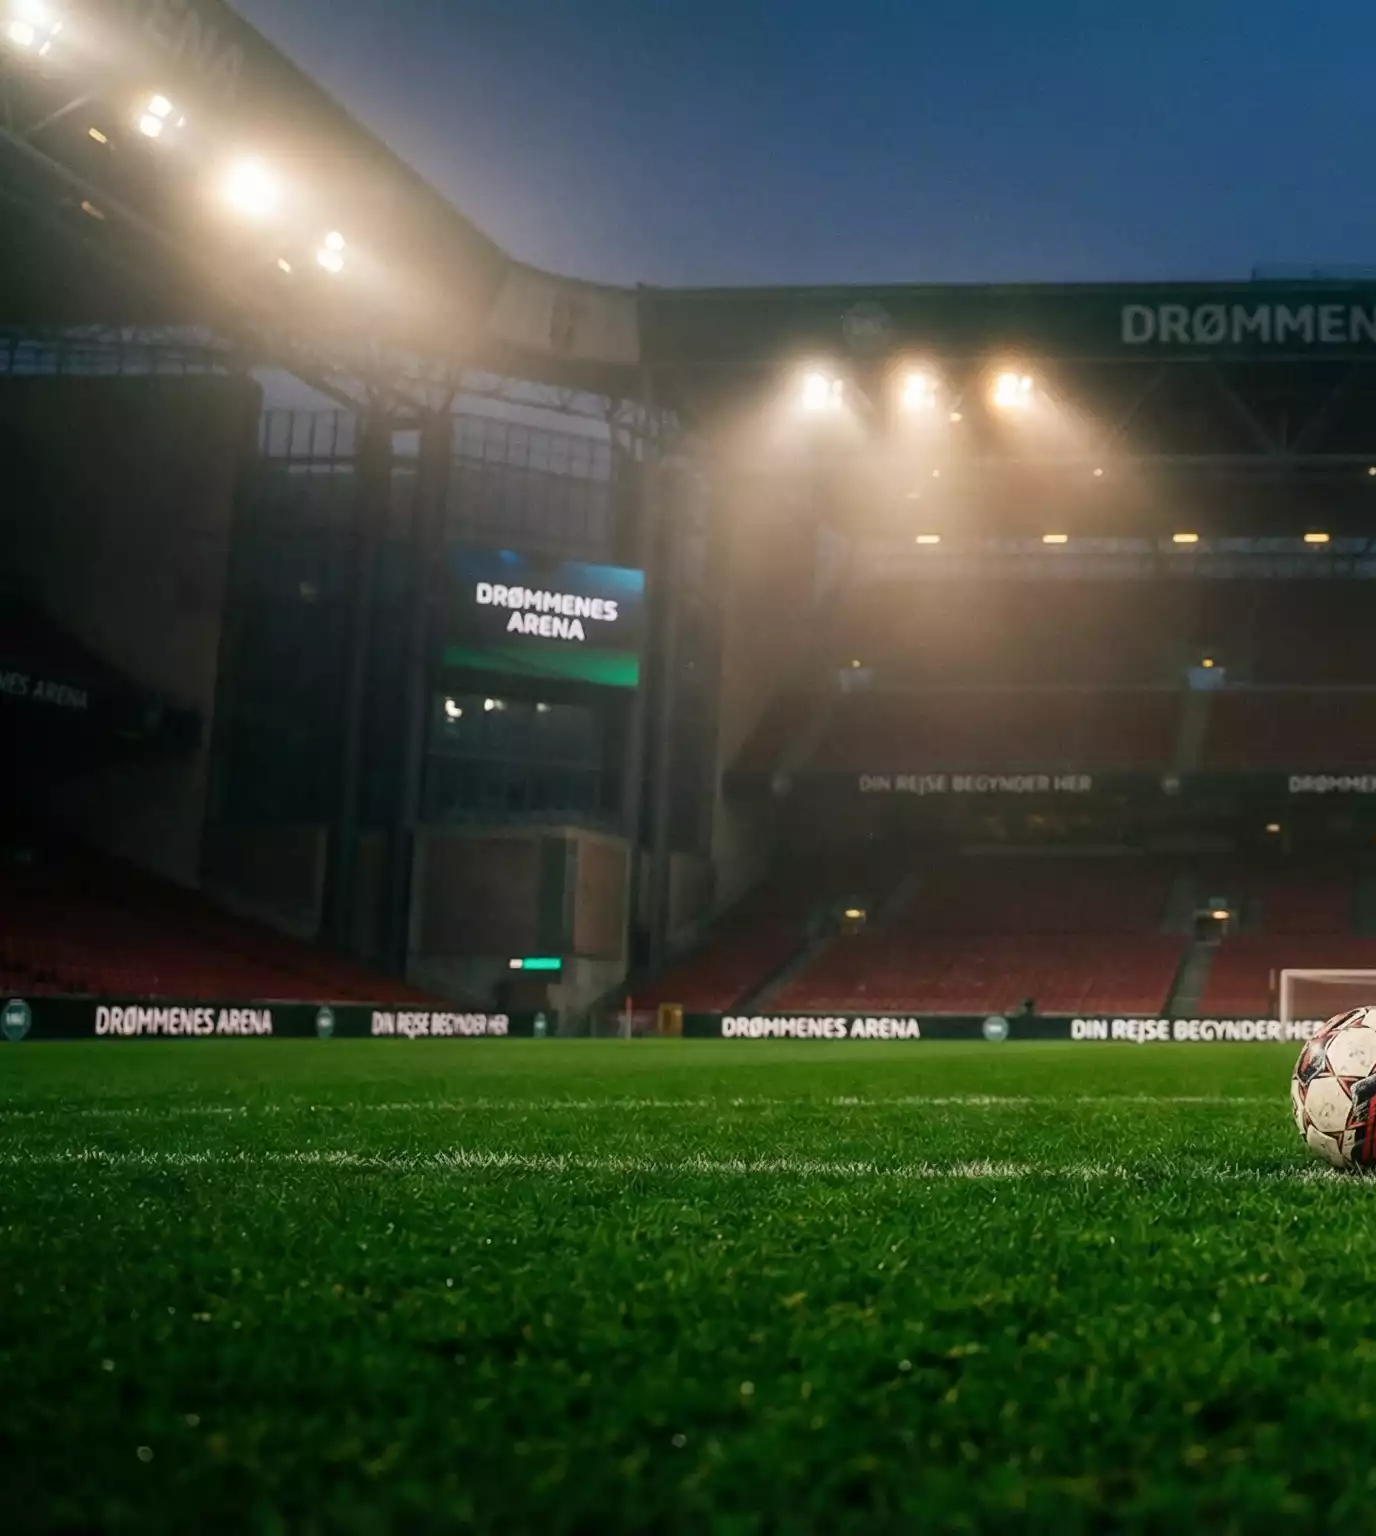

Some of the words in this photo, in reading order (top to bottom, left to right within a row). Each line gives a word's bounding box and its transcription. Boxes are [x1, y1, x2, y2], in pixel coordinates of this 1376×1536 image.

[476, 582, 619, 622] DRØMMENES
[506, 611, 585, 641] ARENA
[859, 774, 891, 792] DIN
[895, 774, 947, 796] REJSE
[952, 774, 1050, 793] BEGYNDER
[1054, 774, 1092, 793] HER
[95, 1005, 215, 1036] DRØMMENES
[216, 1008, 273, 1036] ARENA
[721, 1016, 848, 1039] DRØMMENES
[850, 1017, 920, 1039] ARENA
[1070, 1018, 1108, 1040] DIN
[1111, 1018, 1170, 1044] REJSE
[1173, 1019, 1283, 1041] BEGYNDER
